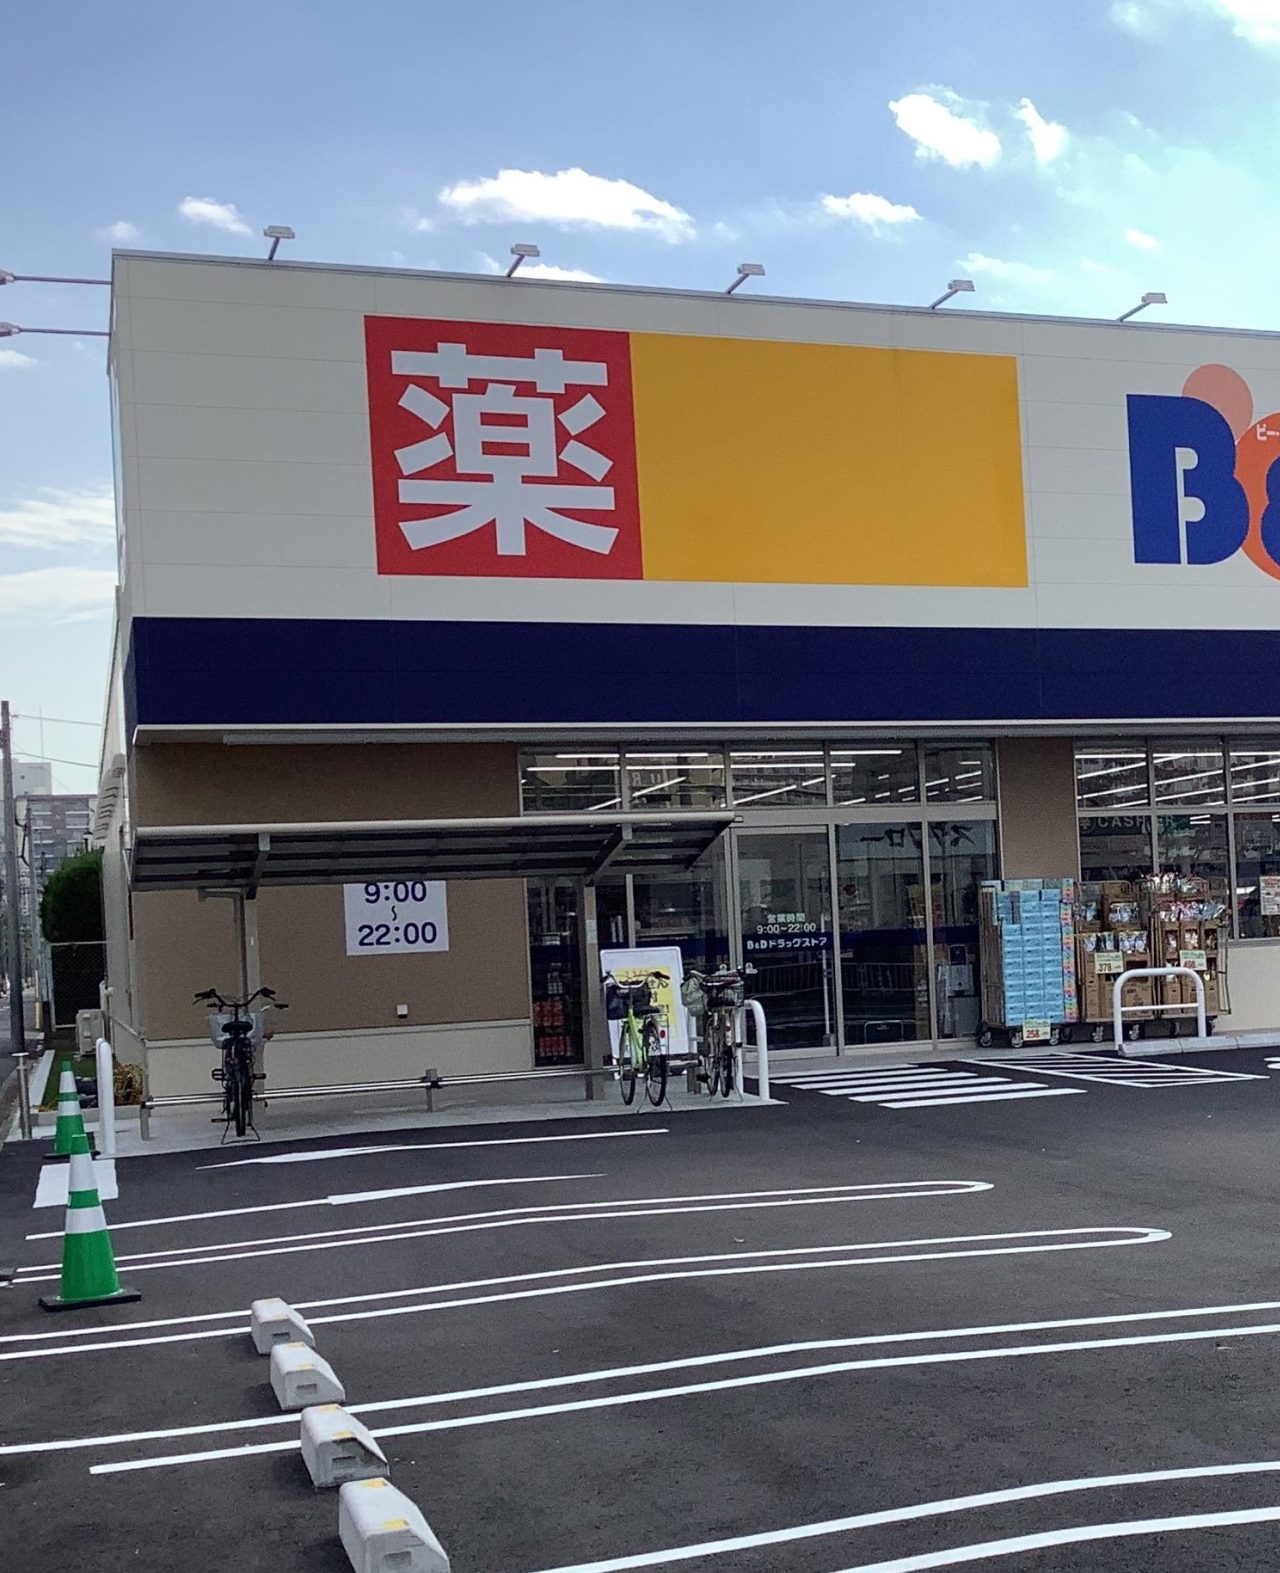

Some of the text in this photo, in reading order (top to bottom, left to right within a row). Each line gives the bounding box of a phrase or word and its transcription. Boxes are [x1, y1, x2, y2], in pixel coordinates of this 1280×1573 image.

[390, 342, 620, 557] 薬
[364, 881, 427, 904] 9:00
[358, 921, 437, 947] 22:00
